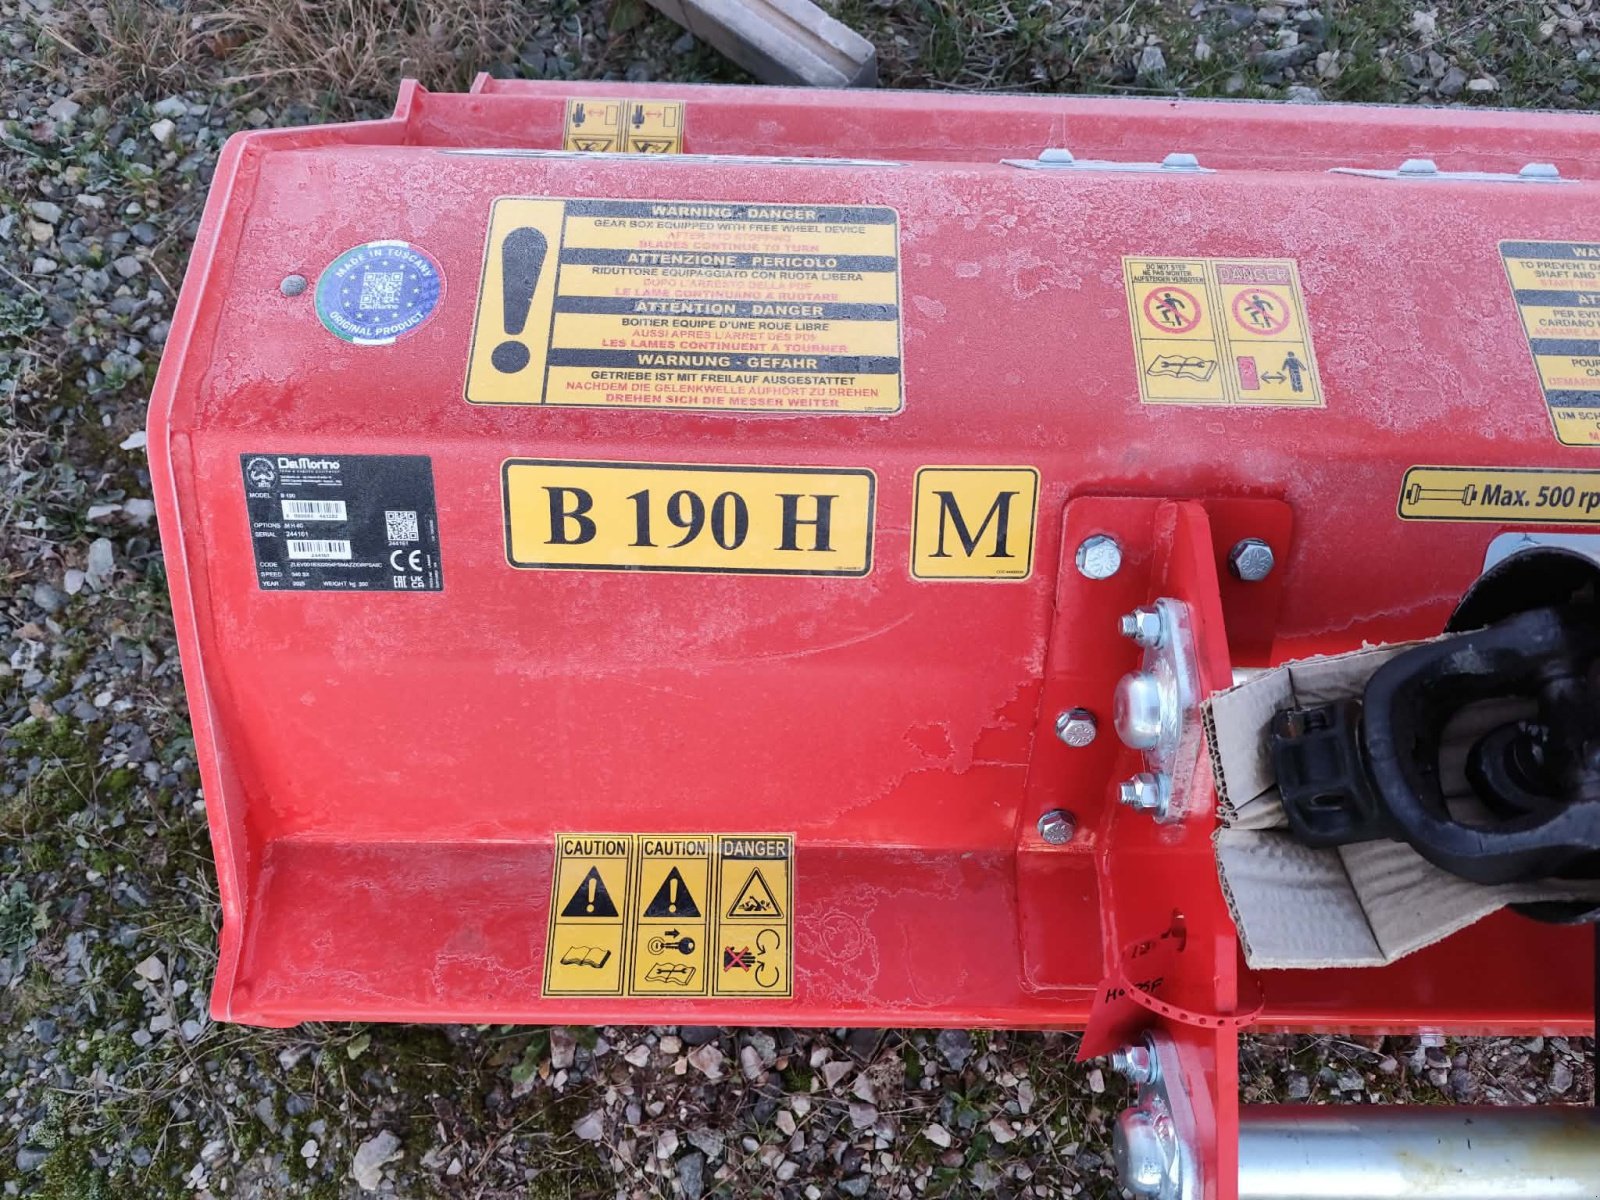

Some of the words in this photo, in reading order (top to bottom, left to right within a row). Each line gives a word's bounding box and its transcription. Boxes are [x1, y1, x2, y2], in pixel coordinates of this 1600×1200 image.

[651, 205, 732, 217] WARNING
[747, 208, 817, 220] DANGER
[594, 219, 626, 228] GEAR
[629, 220, 654, 229] BOX
[657, 220, 714, 230] EQUIPPED
[717, 223, 745, 231] WITH
[749, 224, 779, 232] FREE
[781, 225, 822, 233] WHEEL
[824, 226, 866, 234] DEVICE
[639, 241, 688, 249] BLADES
[692, 242, 758, 251] CONTINUE
[335, 253, 367, 278] MADE
[369, 249, 383, 258] IN
[387, 248, 433, 278] TUSCANY
[627, 252, 737, 265] ATTENZIONE
[752, 256, 838, 268] PERICOLO
[1519, 261, 1534, 269] TO
[1536, 262, 1586, 270] PREVENT
[591, 266, 659, 276] RIDUTTORE
[662, 268, 748, 278] EQUIPAGGIATO
[751, 271, 776, 279] CON
[779, 272, 819, 281] RUOTA
[821, 273, 864, 282] LIBERA
[1219, 266, 1290, 283] DANGER
[1535, 270, 1570, 278] SHAFT
[1573, 271, 1596, 279] AND
[635, 288, 671, 297] LAME
[634, 301, 736, 314] ATTENTION
[752, 305, 824, 316] DANGER
[1552, 309, 1576, 318] PER
[329, 310, 373, 336] ORIGINAL
[375, 311, 426, 336] PRODUCT
[621, 317, 669, 327] BOITIER
[672, 319, 716, 329] EQUIPE
[719, 320, 756, 330] D'UNE
[759, 322, 792, 331] ROUE
[795, 323, 830, 331] LIBRE
[1539, 318, 1595, 327] CARDANO
[632, 329, 669, 338] AUSSI
[671, 330, 711, 339] APRES
[602, 338, 626, 348] LES
[630, 340, 675, 349] LAMES
[679, 341, 768, 351] CONTINUENT
[770, 344, 780, 352] A
[784, 344, 849, 353] TOURNER
[637, 353, 731, 367] WARNUNG
[747, 357, 818, 370] GEFAHR
[590, 370, 652, 381] GETRIEBE
[655, 372, 674, 381] IST
[676, 373, 698, 382] MIT
[701, 373, 759, 384] FREILAUF
[762, 376, 856, 386] AUSGESTATTET
[566, 381, 628, 391] NACHDEM
[631, 383, 651, 392] DIE
[654, 383, 745, 395] GELENKWELLE
[808, 387, 825, 397] ZU
[828, 388, 879, 398] DREHEN
[605, 393, 662, 404] DREHEN
[665, 395, 698, 405] SICH
[702, 396, 725, 405] DIE
[728, 397, 783, 407] MESSER
[788, 399, 839, 408] WEITER
[1557, 411, 1576, 420] UM
[1480, 483, 1530, 508] Max.
[1536, 485, 1575, 508] 500
[541, 485, 598, 546] B
[625, 488, 750, 551] 190
[774, 493, 839, 552] H
[928, 490, 1021, 559] M
[564, 839, 626, 856] CAUTION
[644, 840, 706, 857] CAUTION
[724, 840, 786, 857] DANGER
